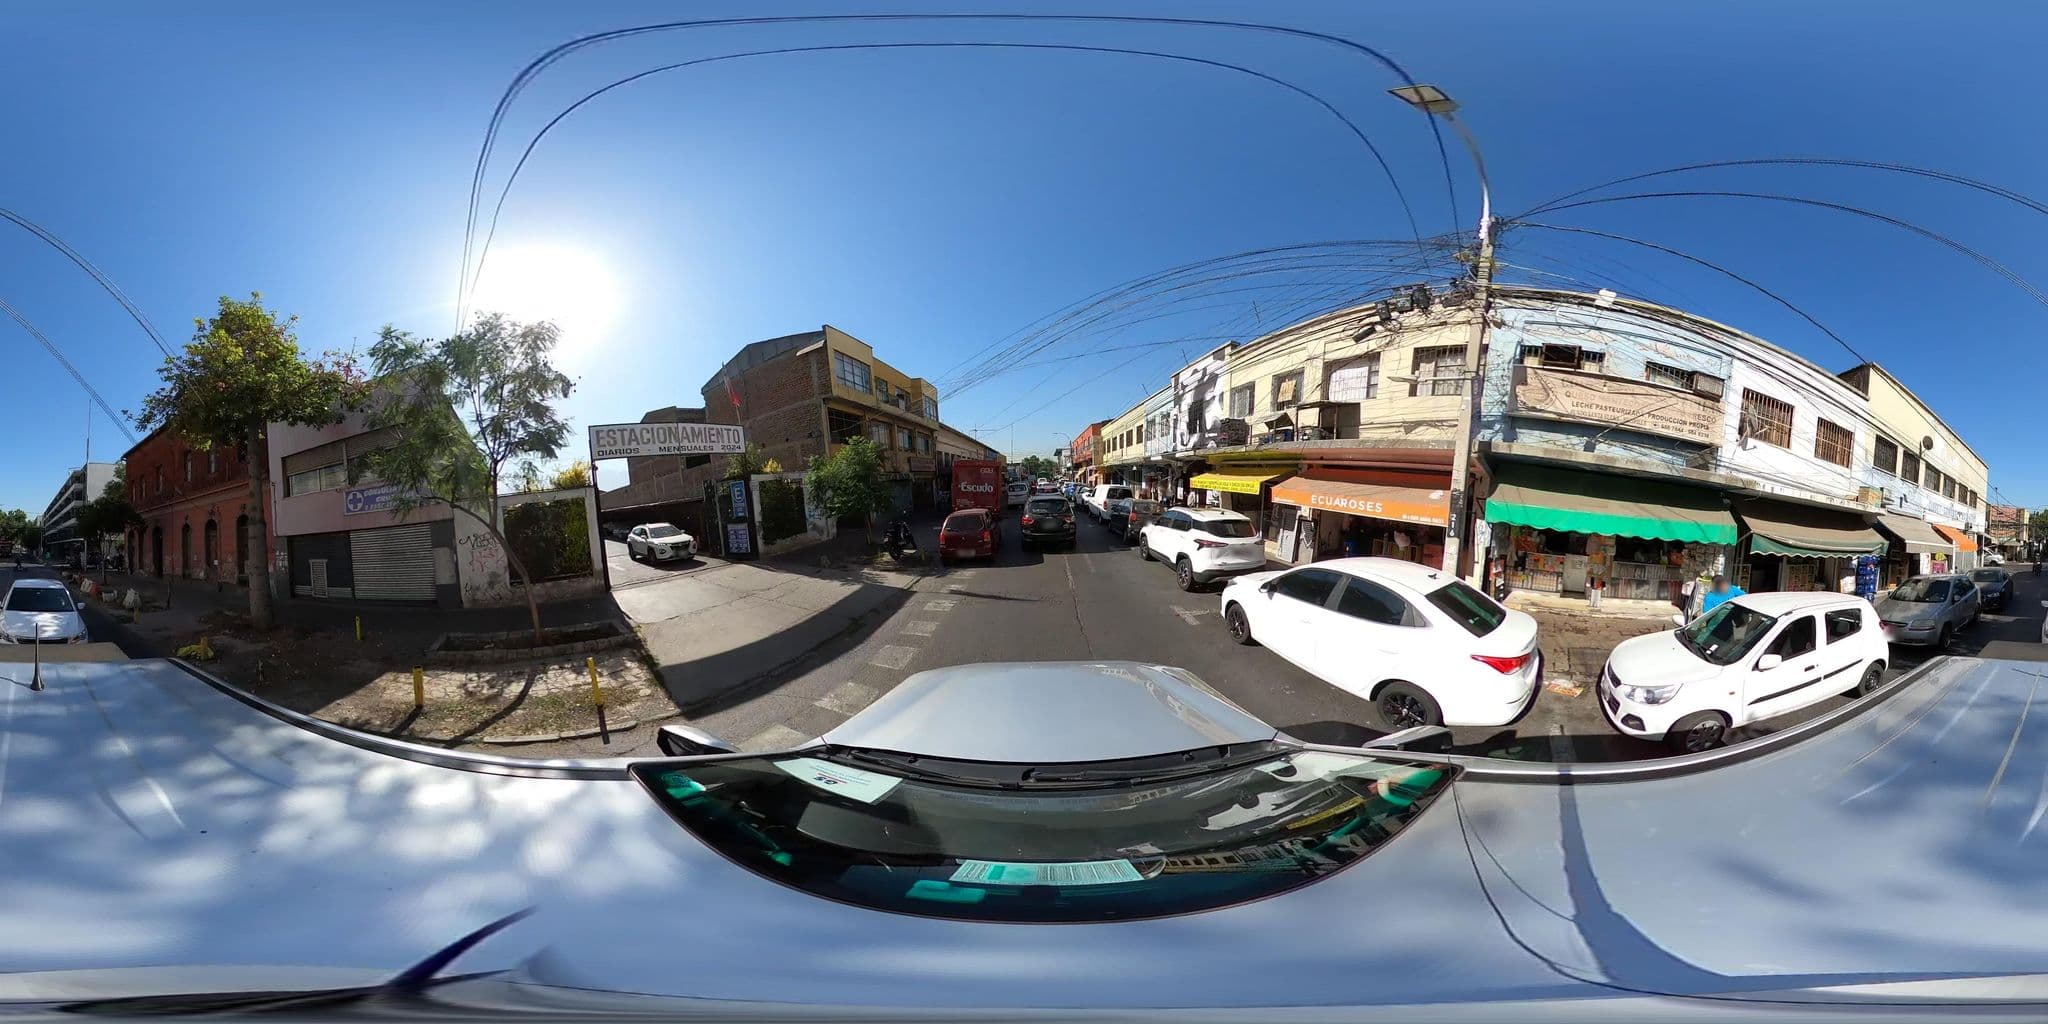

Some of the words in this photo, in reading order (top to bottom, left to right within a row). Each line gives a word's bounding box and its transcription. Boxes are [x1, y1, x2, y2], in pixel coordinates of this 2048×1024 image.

[1571, 400, 1594, 410] LECHE
[595, 426, 741, 448] ESTACIONAMIENTO
[597, 447, 640, 457] DIARIOS
[658, 445, 714, 454] MENSUALES
[960, 481, 994, 493] Escudo
[1311, 494, 1383, 513] ECUAROSES
